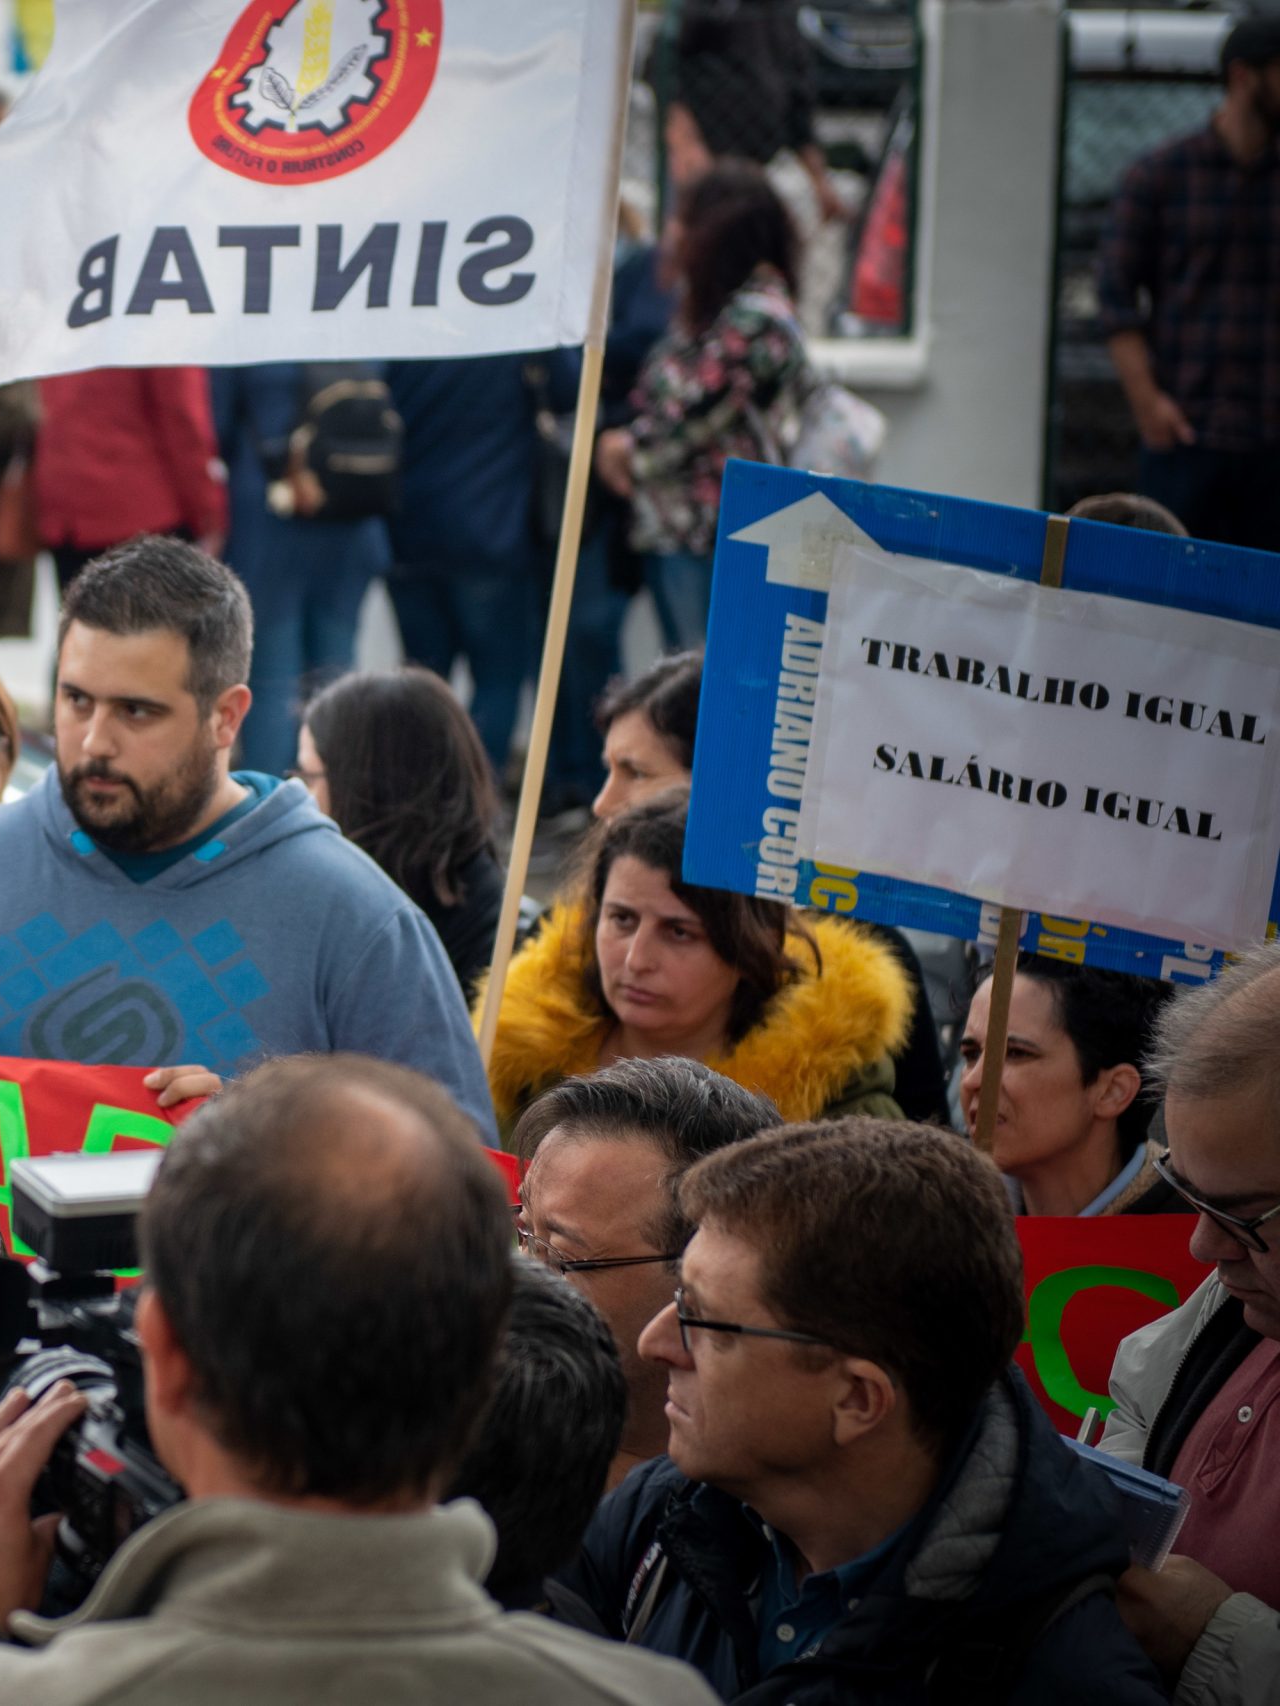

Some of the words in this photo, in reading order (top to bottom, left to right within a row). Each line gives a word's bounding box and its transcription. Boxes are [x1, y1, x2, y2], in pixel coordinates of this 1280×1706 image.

[767, 612, 825, 800] ADRIANO
[861, 637, 1110, 711] TRABALHO
[1122, 690, 1267, 745] IGUAL
[873, 743, 1068, 809] SALÁRIO
[1081, 784, 1222, 841] IGUAL
